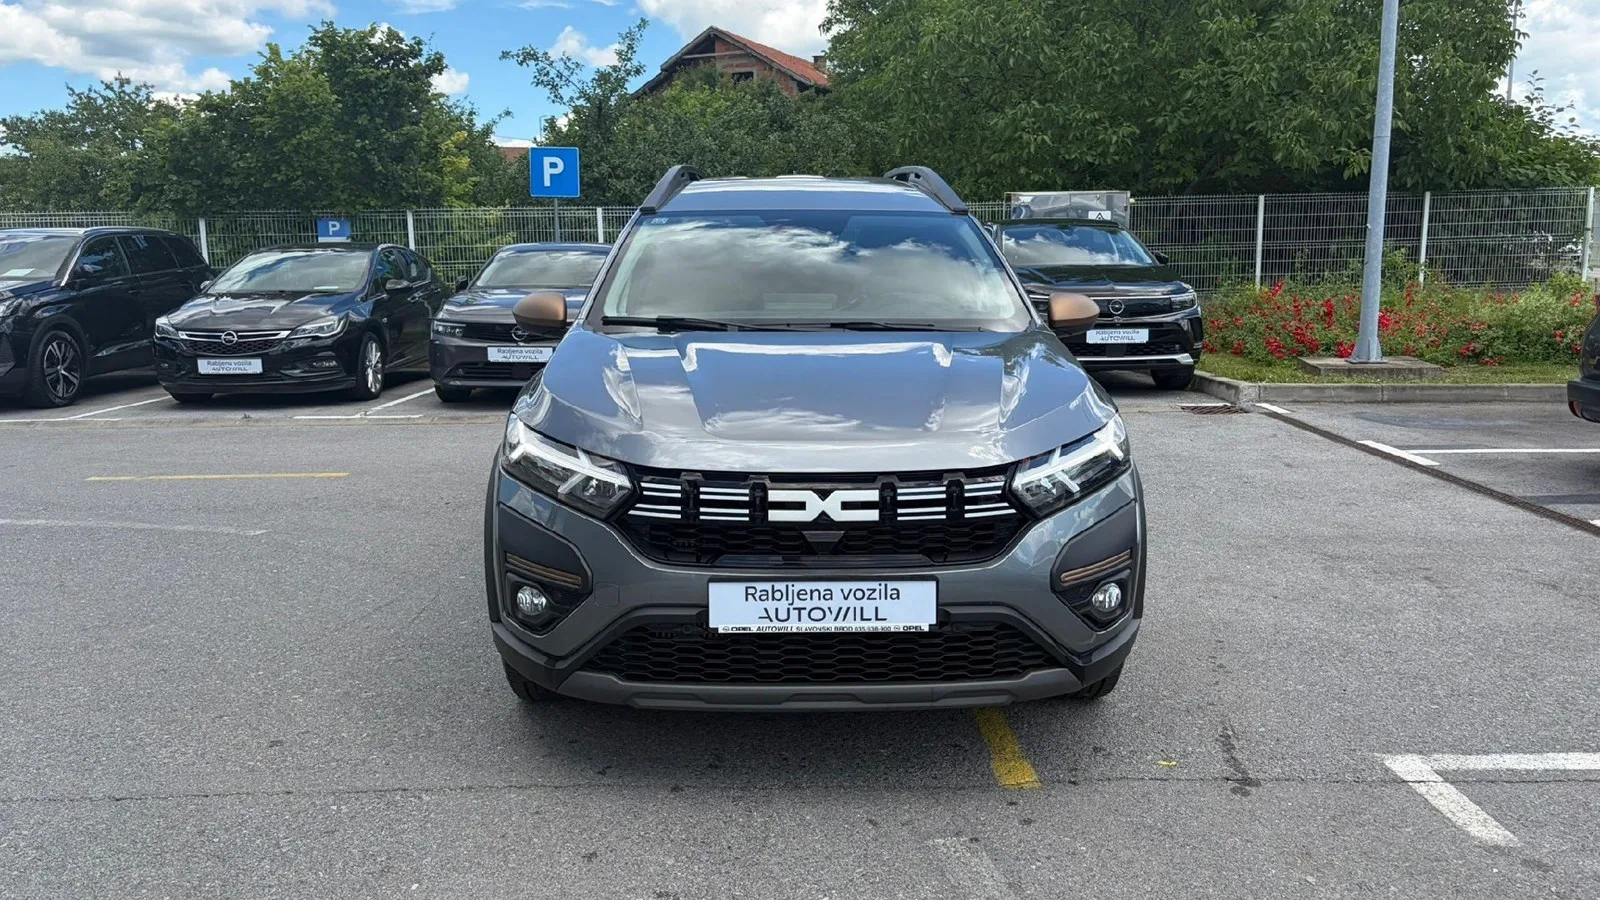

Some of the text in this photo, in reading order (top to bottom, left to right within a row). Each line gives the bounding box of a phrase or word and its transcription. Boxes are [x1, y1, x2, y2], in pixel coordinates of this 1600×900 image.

[543, 156, 564, 187] P
[328, 221, 340, 236] P
[745, 583, 900, 606] Rabljena vozila
[758, 606, 887, 622] AUTOWILL
